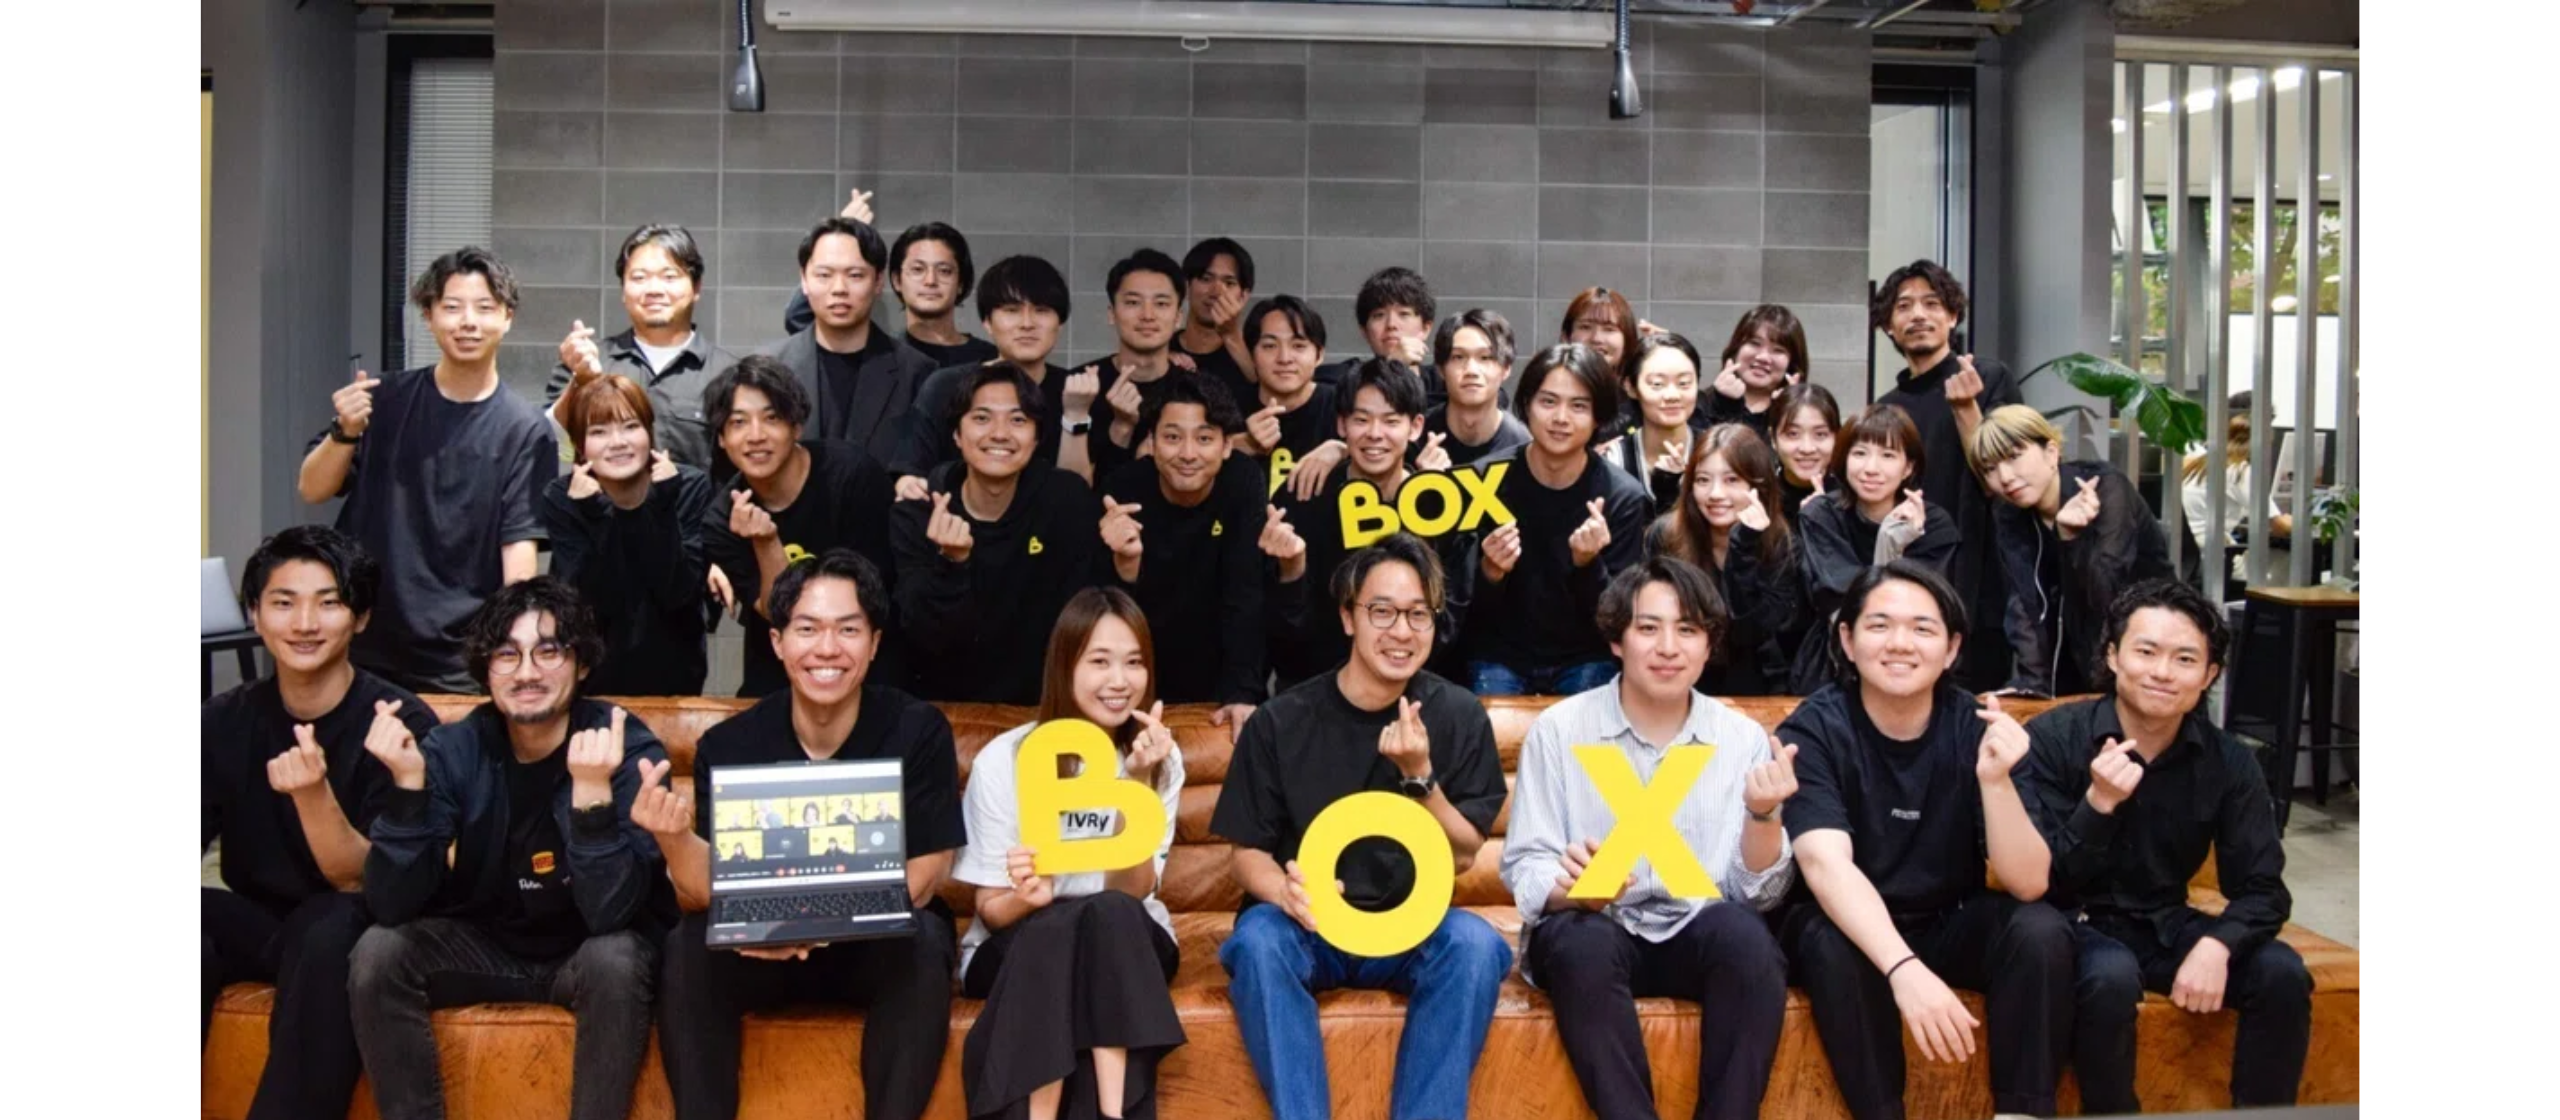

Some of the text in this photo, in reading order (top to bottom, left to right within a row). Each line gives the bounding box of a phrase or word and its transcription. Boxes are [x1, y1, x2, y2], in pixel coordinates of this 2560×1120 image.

[1339, 462, 1517, 549] BOX
[1016, 718, 1721, 957] B O X
[1067, 812, 1110, 832] IVRy
